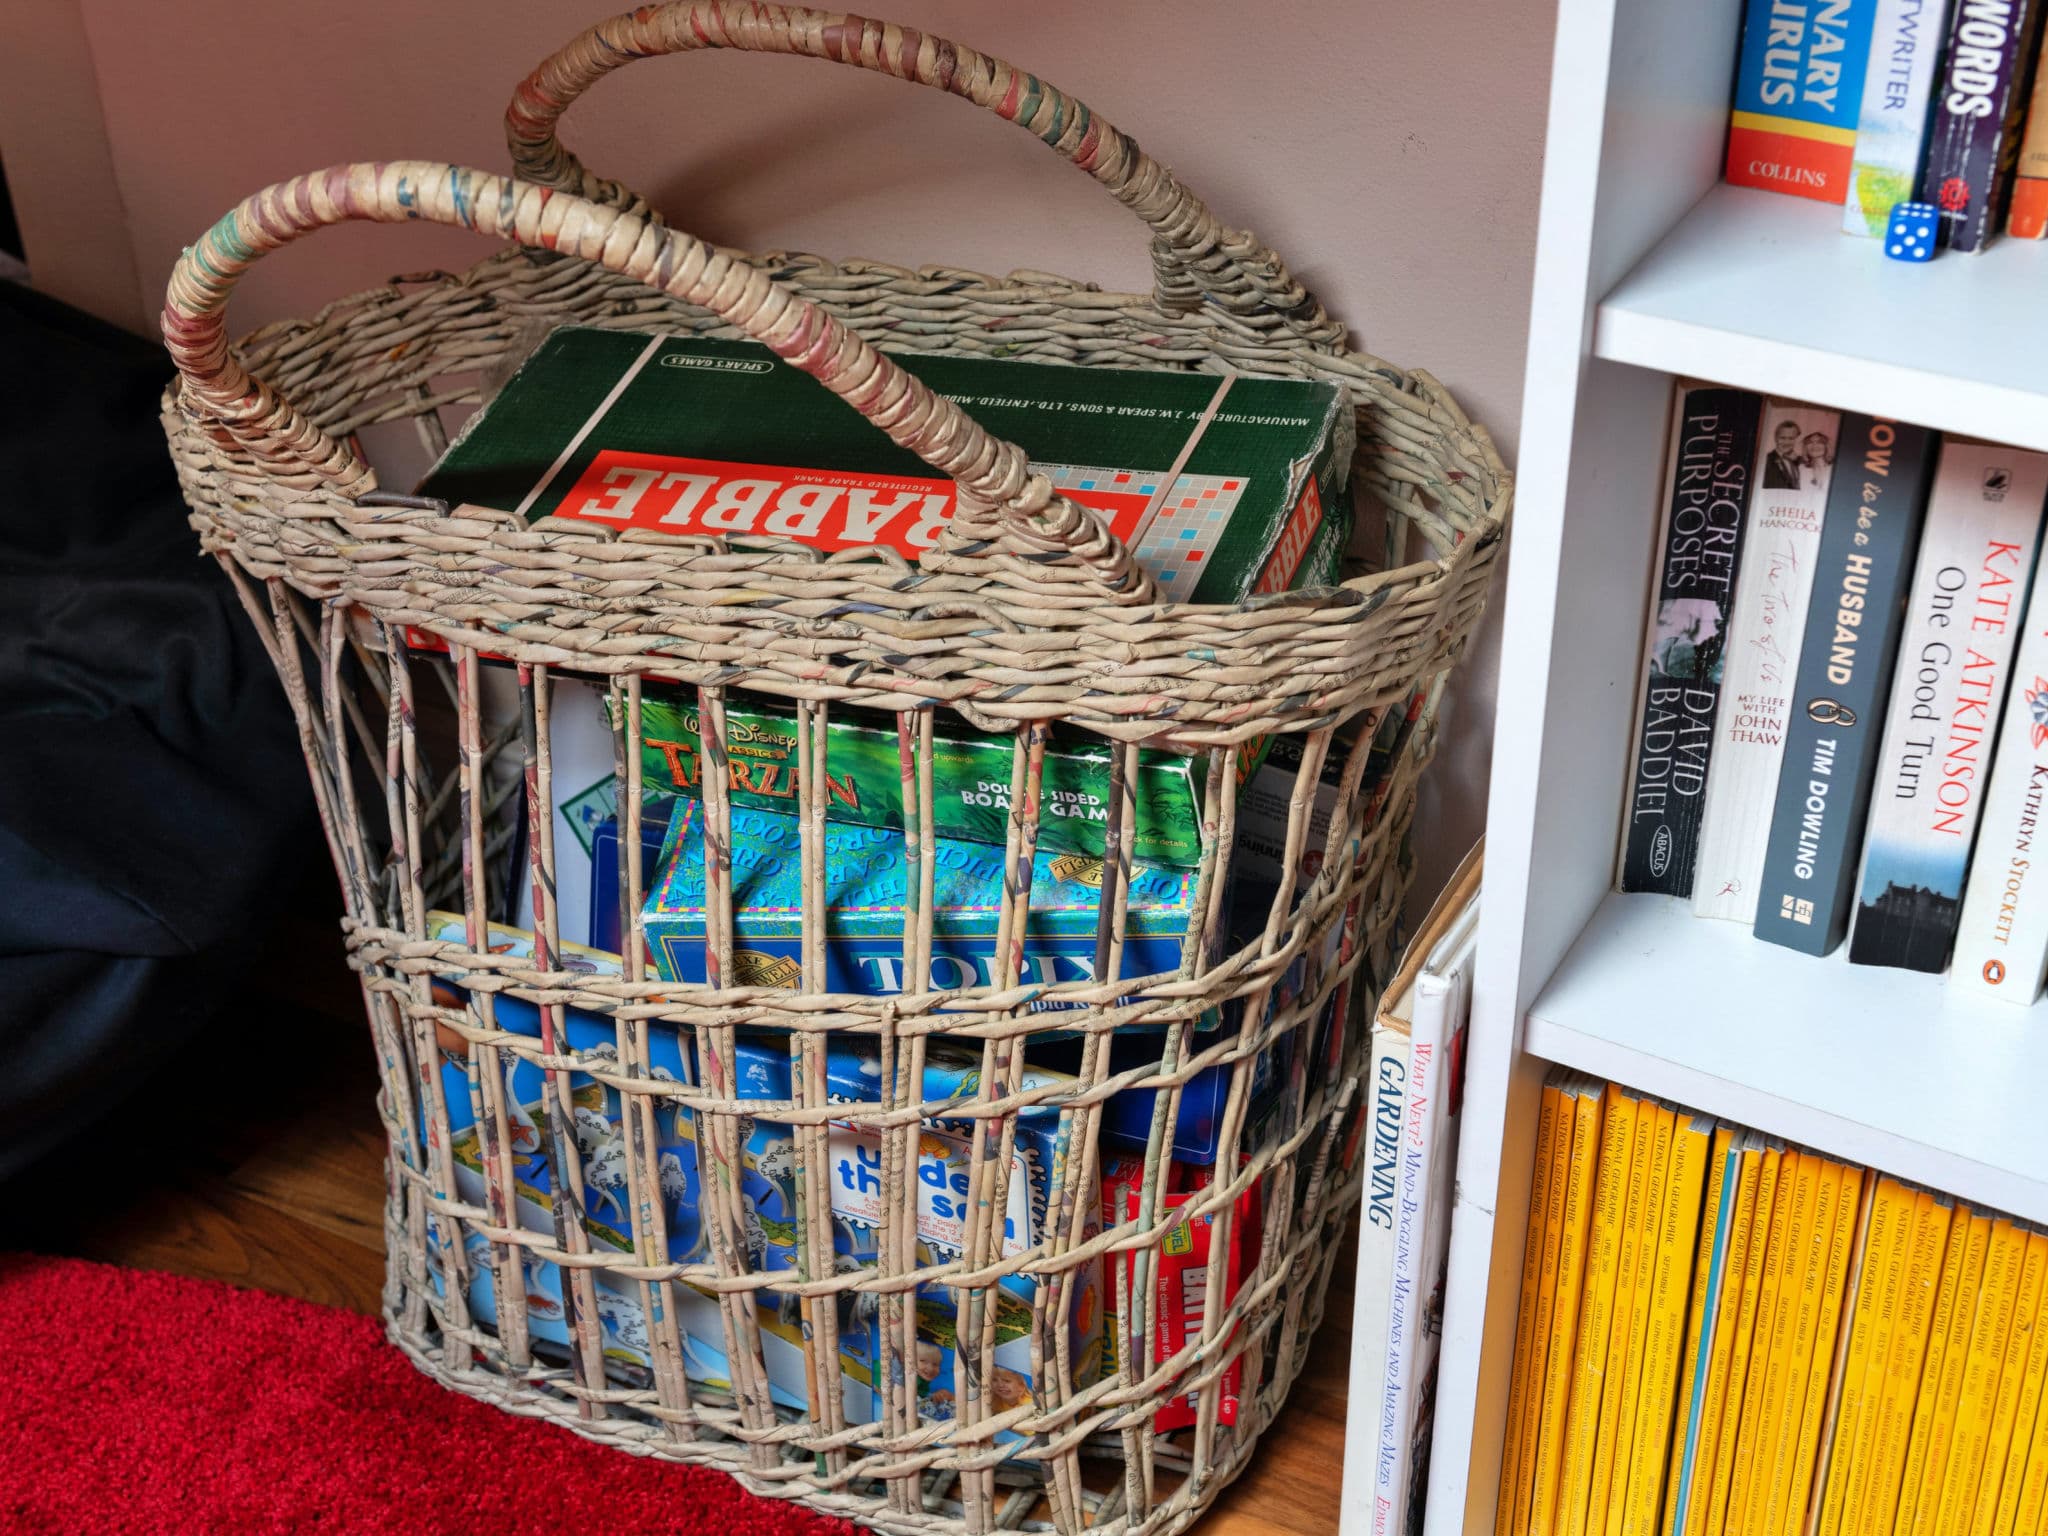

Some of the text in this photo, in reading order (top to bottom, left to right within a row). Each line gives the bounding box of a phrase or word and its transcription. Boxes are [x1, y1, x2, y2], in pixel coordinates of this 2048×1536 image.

[1749, 160, 1827, 188] COLLINS
[671, 357, 764, 371] SPEAR'S GAMES
[1106, 405, 1115, 414] &
[1188, 410, 1205, 420] BY
[792, 474, 933, 492] REGISTERED TRADE MARK
[1666, 414, 1719, 589] PURPOSES
[579, 466, 1010, 551] RABBLE
[1699, 431, 1746, 593] THE SECRET
[1759, 518, 1822, 533] HANCOCK
[1768, 505, 1817, 521] SHEILA
[1857, 505, 1878, 531] be
[1853, 531, 1870, 547] a
[1970, 540, 2022, 635] KATE
[1827, 553, 1873, 686] HUSBAND
[1737, 694, 1785, 708] MY LIFE
[1895, 566, 1967, 800] One Good Turn
[1733, 715, 1783, 731] JOHN
[1742, 703, 1777, 715] WITH
[728, 747, 785, 760] ASSICS
[1634, 687, 1681, 824] BADDIEL
[1673, 688, 1715, 797] DAVID
[1729, 729, 1783, 746] THAW
[1931, 648, 1996, 836] ATKINSON
[1050, 803, 1108, 821] GAM
[1051, 790, 1100, 806] SIDED
[1794, 738, 1837, 880] TIM DOWLING
[1145, 838, 1188, 849] for details
[1238, 835, 1284, 864] inning
[1653, 831, 1668, 871] ABACUS
[1993, 763, 2048, 946] KATHRYN STOCKETT
[1412, 1042, 1432, 1091] WHAT
[1369, 1055, 1406, 1231] GARDENING
[1406, 1097, 1428, 1148] NEXT?
[1539, 1106, 1552, 1153] NATIONAL
[1555, 1111, 1568, 1159] NATIONAL
[1573, 1113, 1586, 1161] NATIONAL
[1604, 1104, 1618, 1153] NATIONAL
[1614, 1117, 1628, 1164] NATIONAL
[1634, 1120, 1648, 1169] NATIONAL
[1652, 1125, 1667, 1172] NATIONAL
[1673, 1135, 1688, 1183] NATIONAL
[1397, 1148, 1422, 1272] MIND-BOGGLING
[1533, 1157, 1547, 1218] GEOGRAPHIC
[1550, 1163, 1563, 1224] GEOGRAPHIC
[1566, 1165, 1581, 1225] GEOGRAPHIC
[1597, 1156, 1612, 1216] GEOGRAPHIC
[1606, 1168, 1621, 1228] GEOGRAPHIC
[1627, 1172, 1642, 1232] GEOGRAPHIC
[1644, 1175, 1660, 1235] GEOGRAPHIC
[1700, 1151, 1726, 1263] NATIONAL GEOGRAPHIC
[1742, 1165, 1758, 1214] NATIONAL
[1756, 1167, 1772, 1215] NATIONAL
[1775, 1167, 1791, 1215] NATIONAL
[1793, 1175, 1808, 1219] NATIONAL
[1665, 1186, 1681, 1246] GEOGRAPHIC
[1804, 1181, 1831, 1294] NATIONAL GEOGRAPHIC
[1825, 1184, 1852, 1297] NATIONAL GEOGRAPHIC
[1872, 1199, 1888, 1248] NATIONAL
[1731, 1217, 1749, 1277] GEOGRAPHIC
[1746, 1219, 1764, 1280] GEOGRAPHIC
[1766, 1219, 1783, 1279] GEOGRAPHIC
[1784, 1222, 1801, 1278] GEOGRAPHIC
[1861, 1251, 1880, 1312] GEOGRAPHIC
[1158, 1276, 1172, 1354] The classic game of
[1391, 1278, 1411, 1346] MACHINES
[1387, 1346, 1400, 1379] AND
[1223, 1402, 1232, 1415] up
[1383, 1380, 1401, 1441] AMAZING
[1379, 1446, 1397, 1488] MAZES
